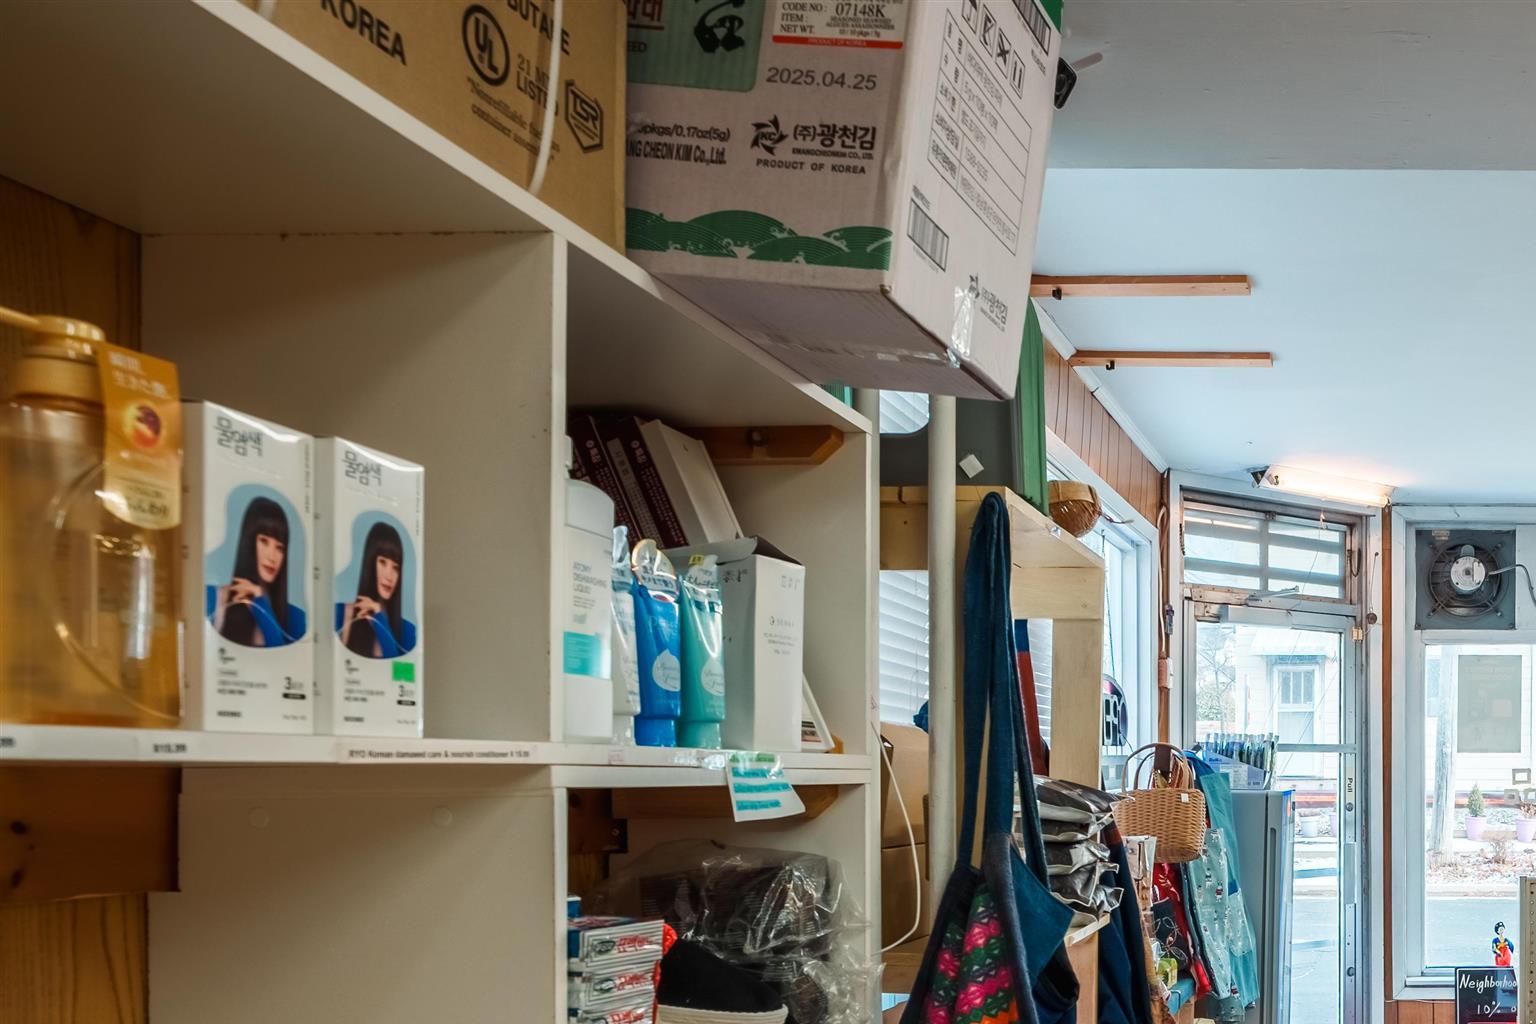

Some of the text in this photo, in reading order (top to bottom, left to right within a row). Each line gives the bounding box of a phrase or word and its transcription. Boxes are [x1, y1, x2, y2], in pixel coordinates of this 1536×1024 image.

[781, 13, 804, 22] ITEM
[321, 0, 407, 66] KOREA
[506, 0, 570, 56] BUTAE
[627, 40, 648, 52] EED
[766, 67, 877, 90] 2025.04.25
[636, 123, 731, 142] pkgs/0.17oz(5g)
[793, 123, 876, 150] (주)광천김
[756, 158, 866, 175] PRODUCT OF KOREA
[1460, 974, 1518, 994] Neighborhoo
[1477, 1000, 1501, 1018] 10%
